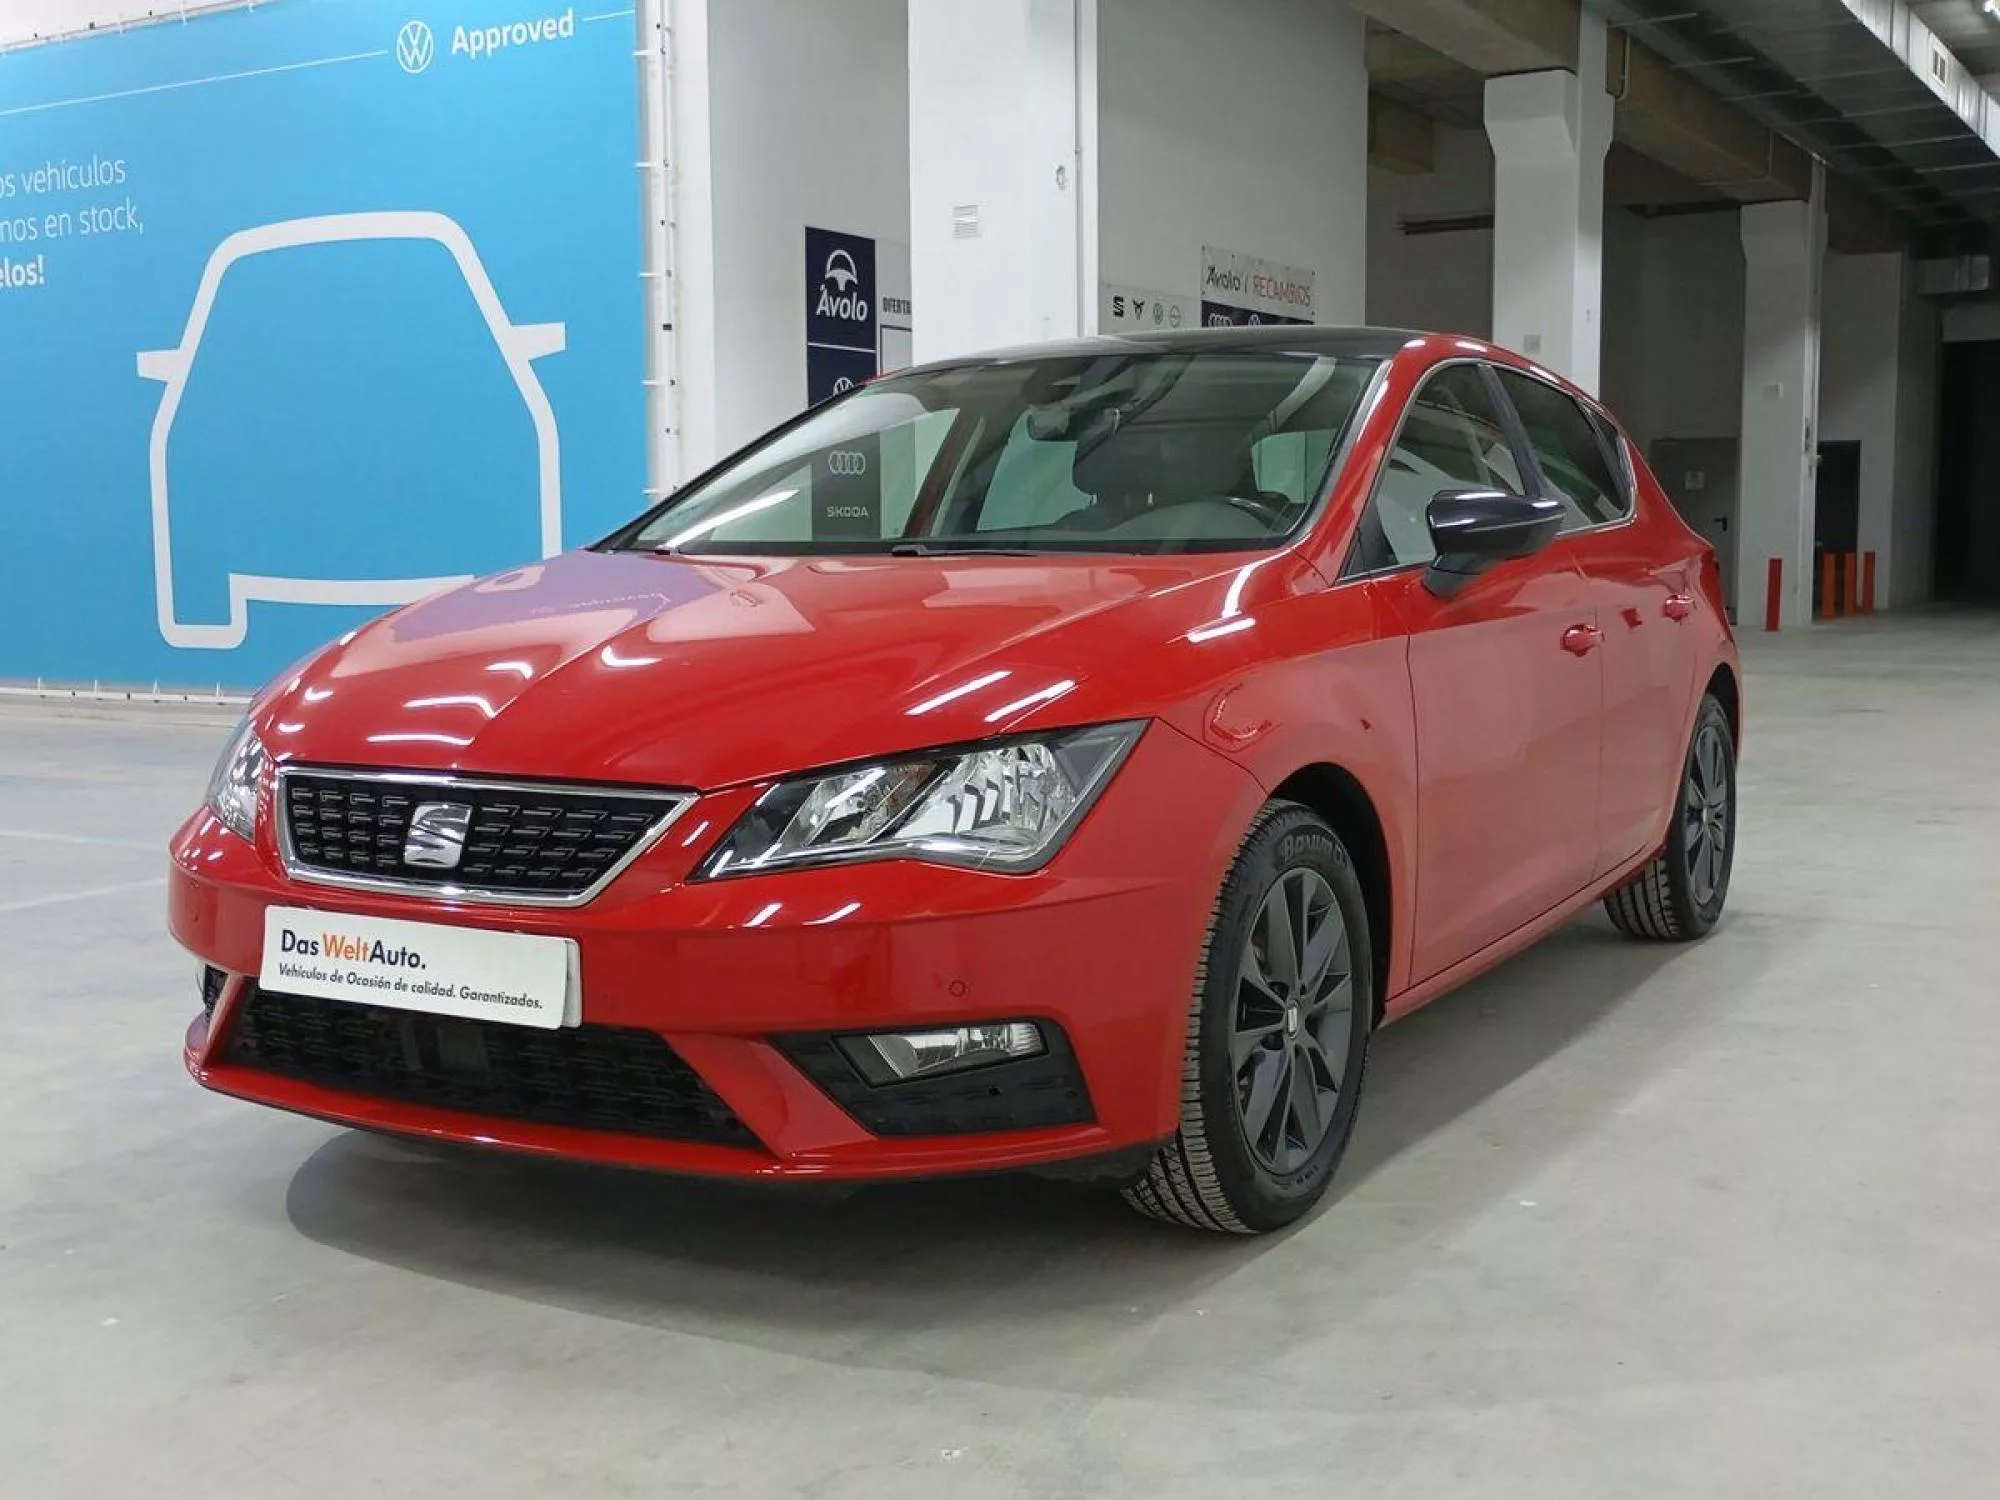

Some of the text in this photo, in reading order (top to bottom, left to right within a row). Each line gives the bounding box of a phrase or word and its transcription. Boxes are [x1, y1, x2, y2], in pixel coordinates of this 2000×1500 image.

[451, 7, 574, 60] Approved
[44, 212, 72, 238] en
[79, 196, 144, 236] stock,
[1253, 274, 1311, 308] RECAMBIOS
[281, 929, 319, 956] Das
[329, 969, 344, 983] de
[346, 971, 391, 990] Ocasión
[394, 977, 409, 991] de
[411, 981, 456, 998] calidad.
[459, 986, 543, 1009] Garantizados.
